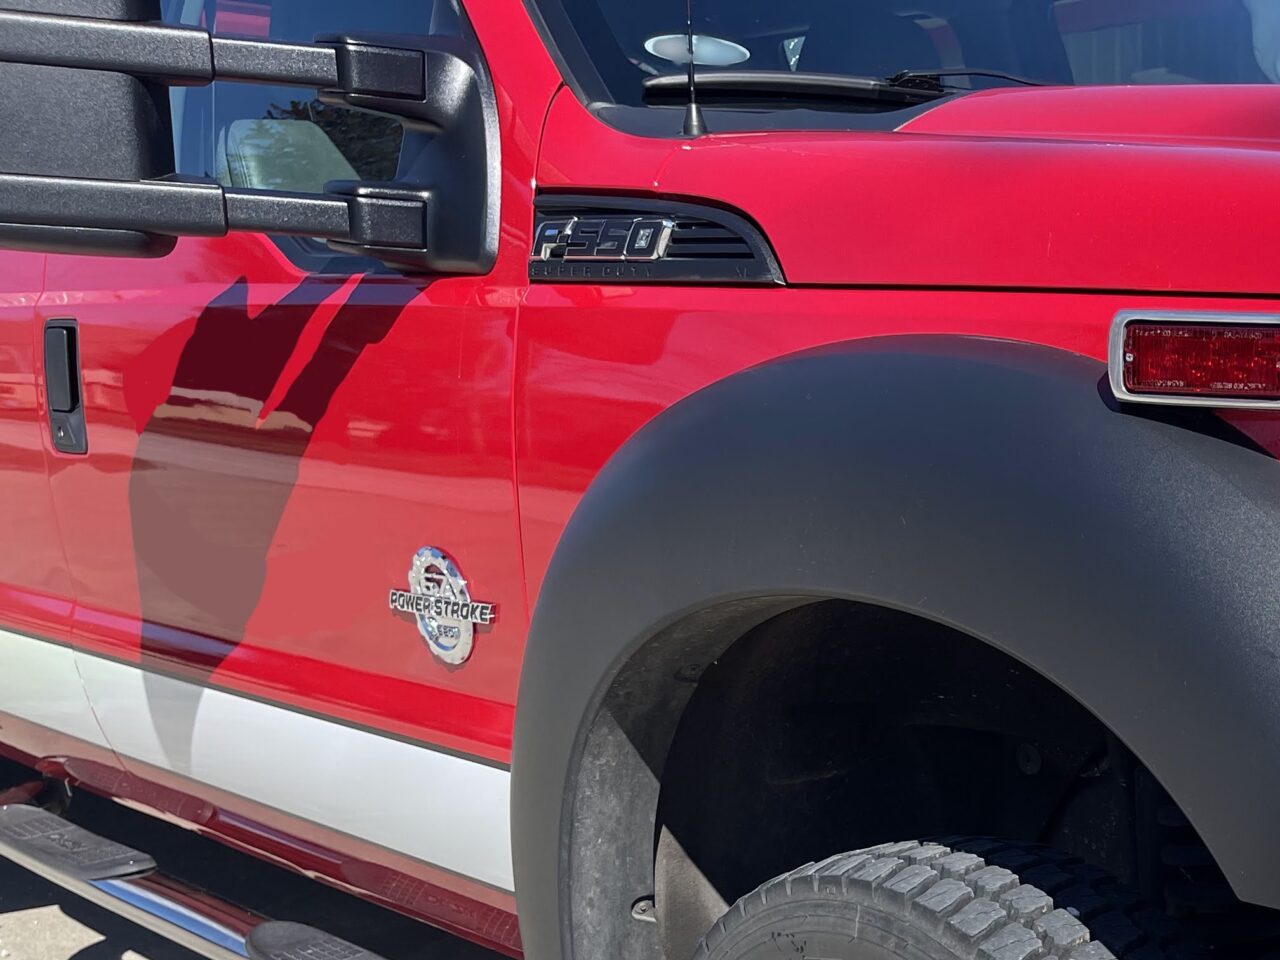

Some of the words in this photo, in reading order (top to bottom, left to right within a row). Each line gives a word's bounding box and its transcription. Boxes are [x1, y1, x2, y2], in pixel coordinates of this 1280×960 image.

[530, 261, 592, 278] SUPER
[600, 261, 653, 278] DUTY
[389, 590, 431, 614] POWER
[433, 597, 490, 623] STROKE
